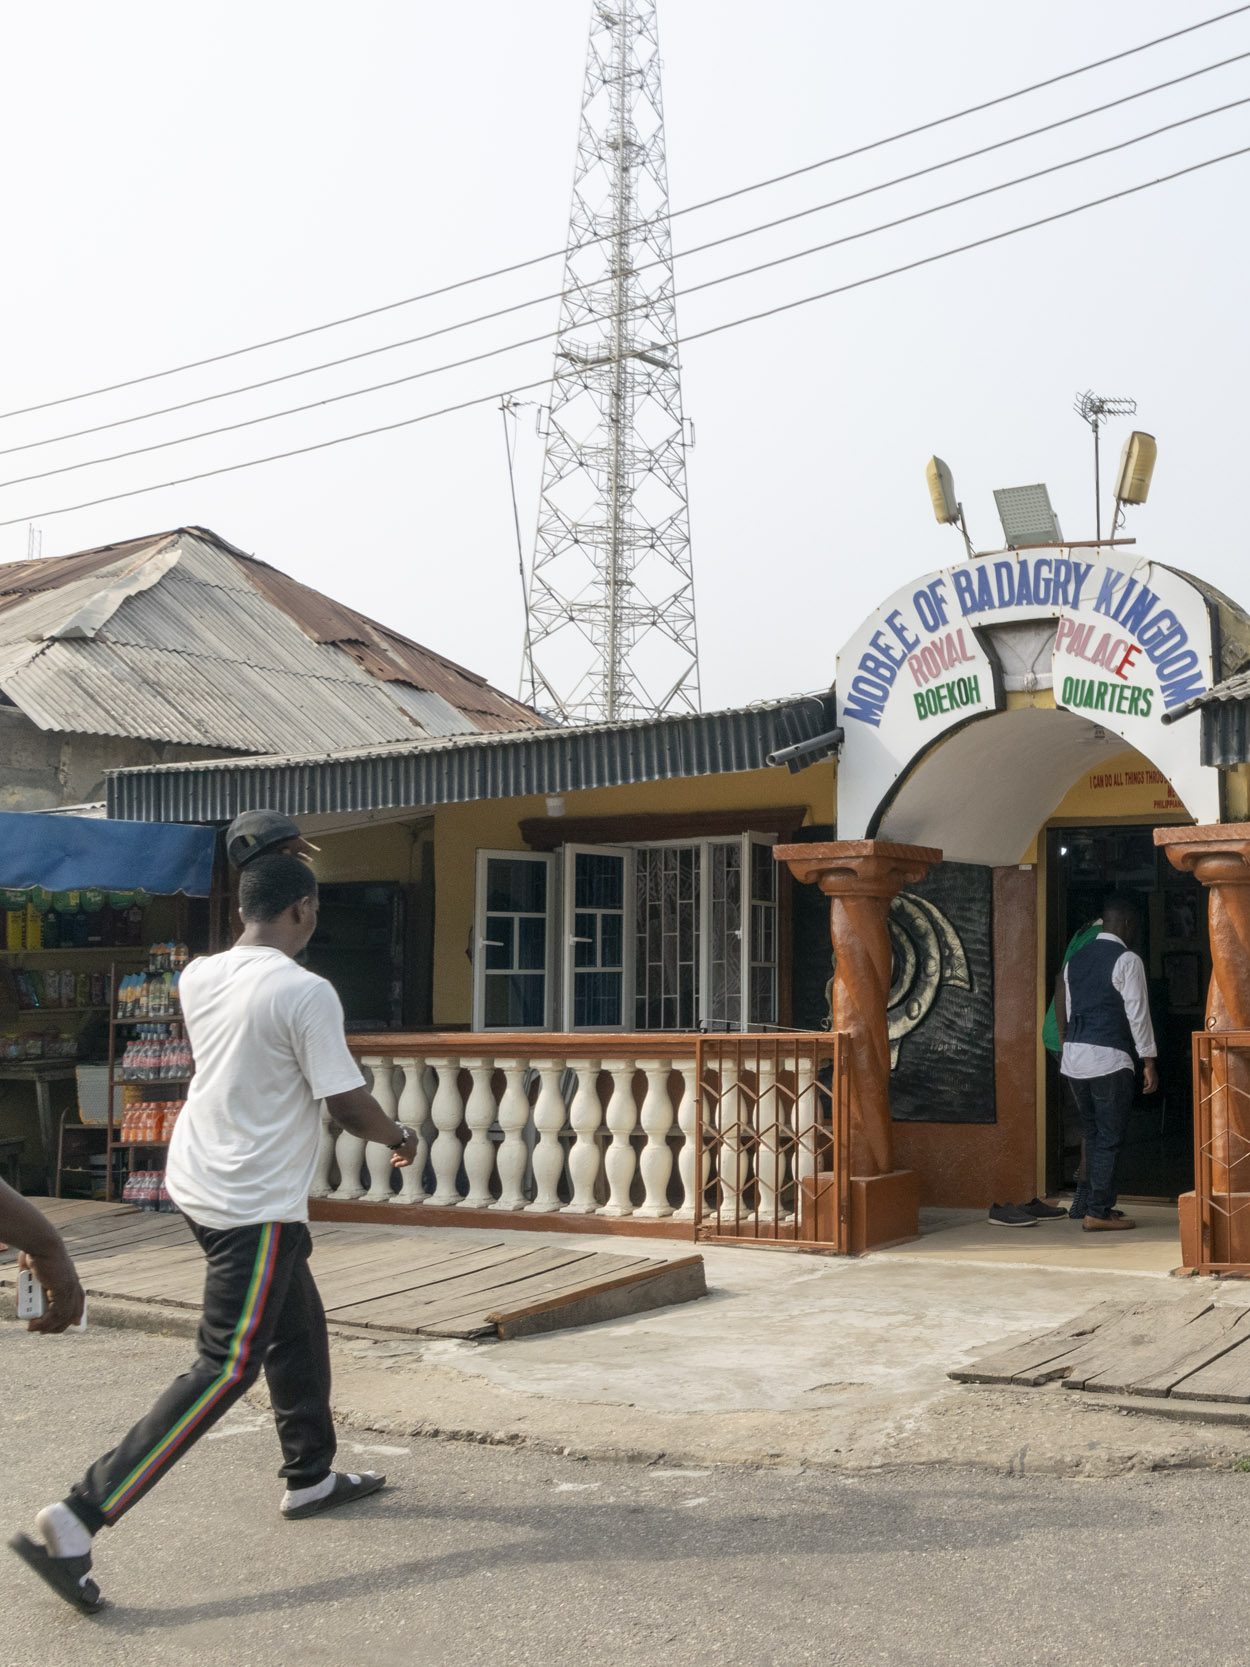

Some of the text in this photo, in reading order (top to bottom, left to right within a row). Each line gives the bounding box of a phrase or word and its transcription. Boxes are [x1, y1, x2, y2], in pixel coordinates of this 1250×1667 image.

[843, 558, 1207, 728] MOBEE OF BADAGRY KINGDOM
[907, 627, 976, 688] ROYAL
[1055, 617, 1143, 681] PALACE
[913, 674, 981, 721] BOEKOH
[1061, 675, 1154, 718] QUARTERS
[1093, 775, 1104, 789] CAN
[1105, 774, 1113, 788] DO
[1113, 772, 1123, 786] ALL
[1125, 771, 1144, 785] THINGS
